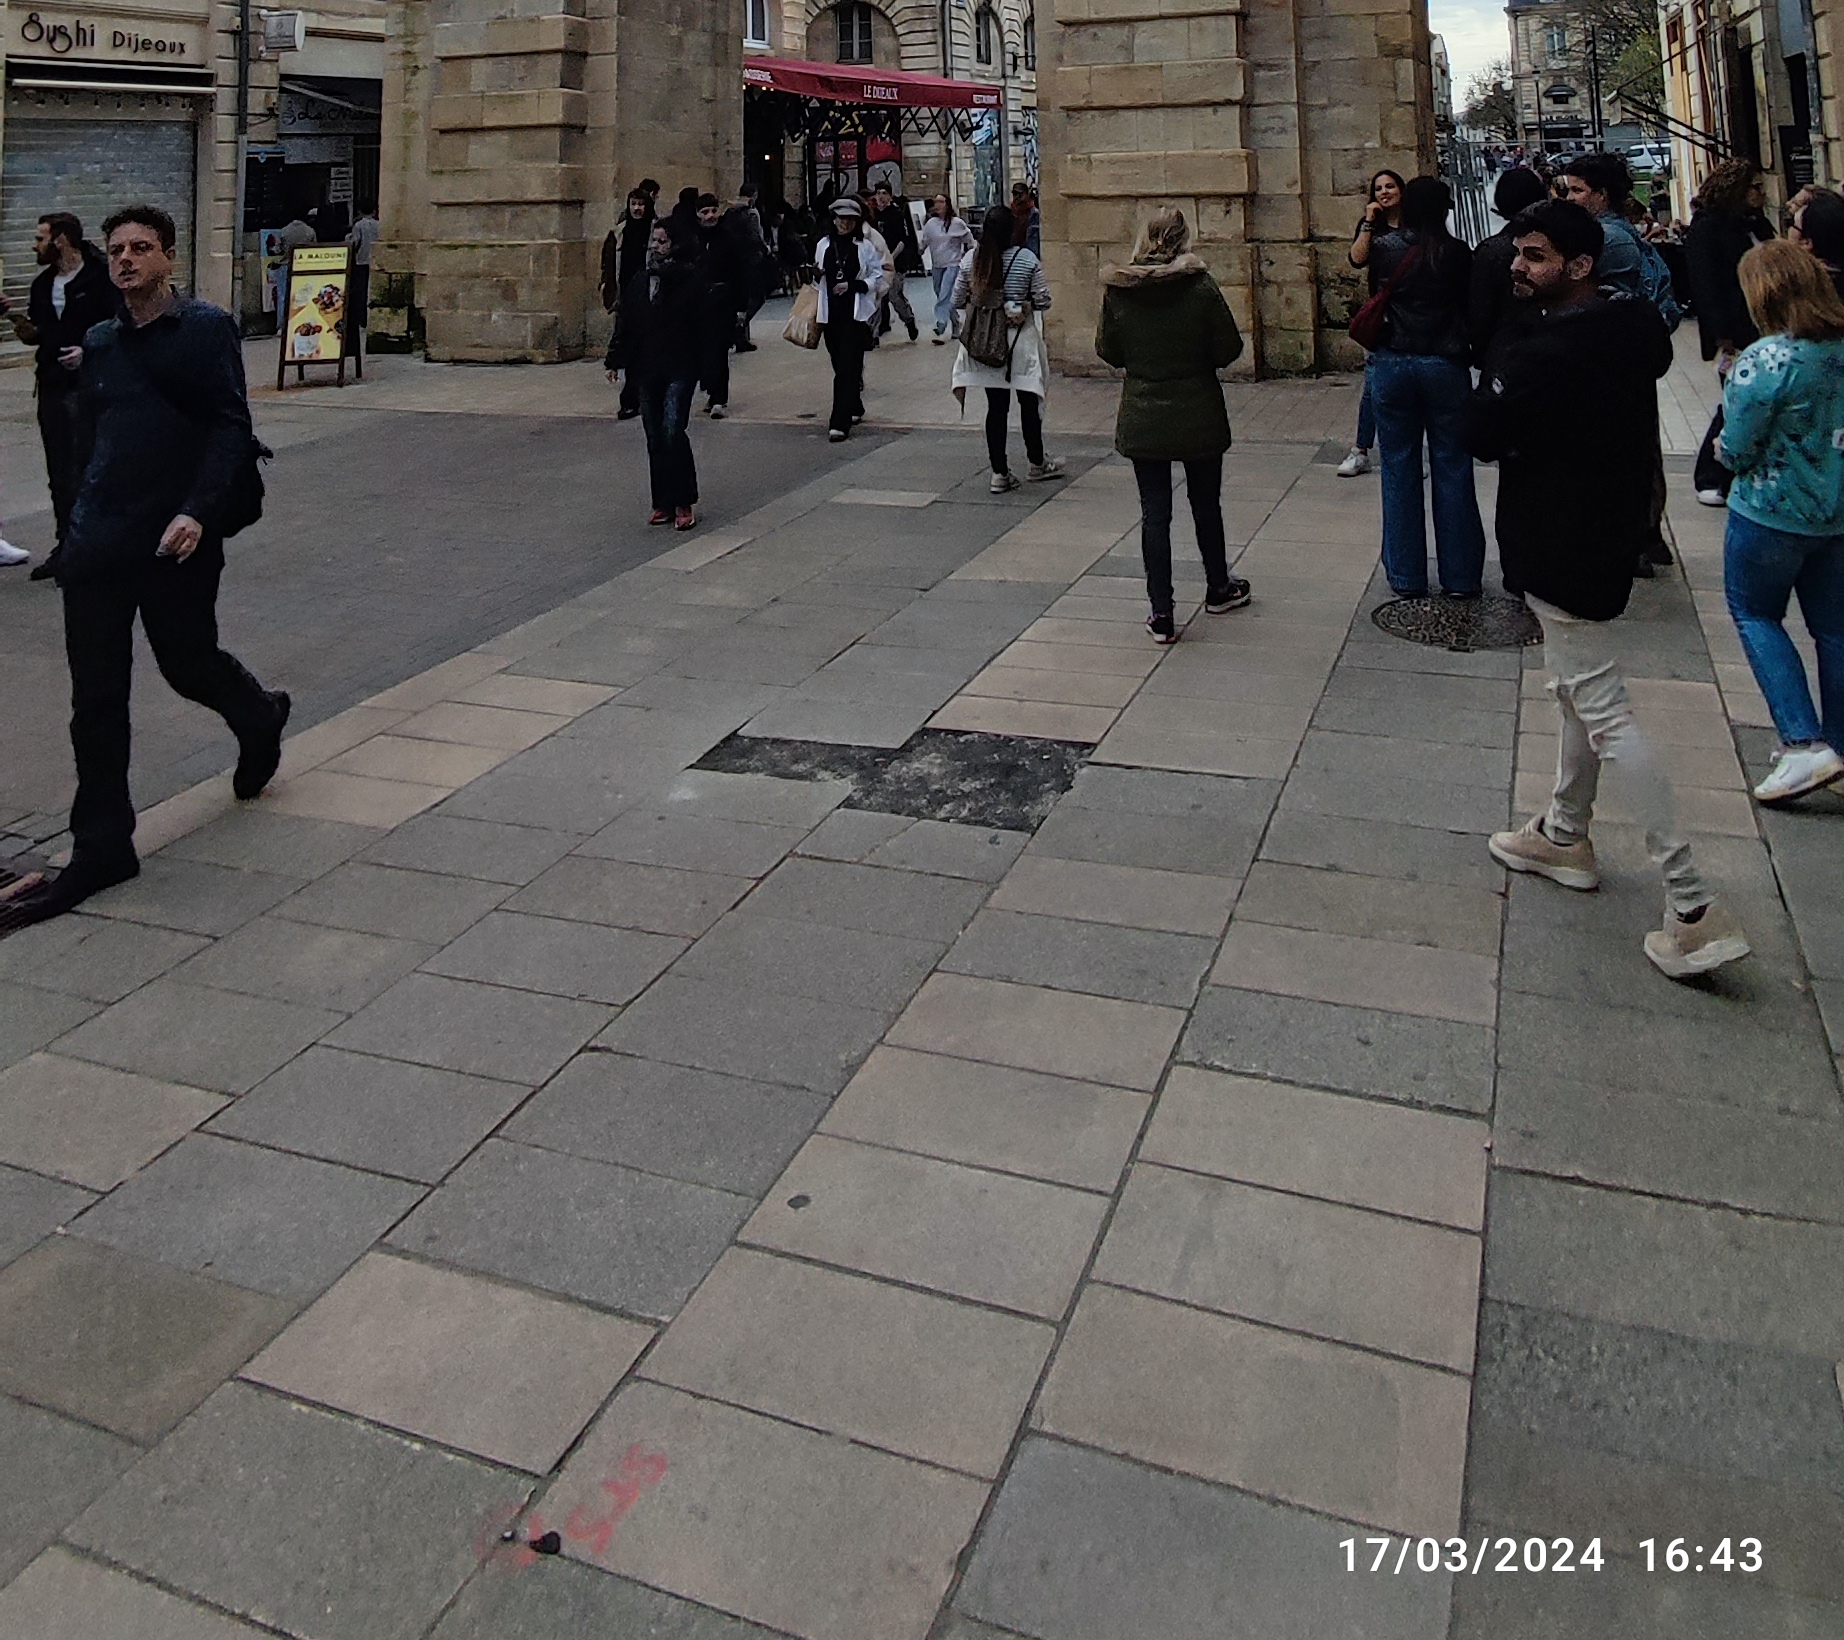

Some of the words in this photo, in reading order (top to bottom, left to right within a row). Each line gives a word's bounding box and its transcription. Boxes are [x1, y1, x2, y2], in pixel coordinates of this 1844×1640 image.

[21, 12, 95, 54] Sushi
[112, 30, 186, 55] Dijeaux
[863, 84, 872, 98] LE
